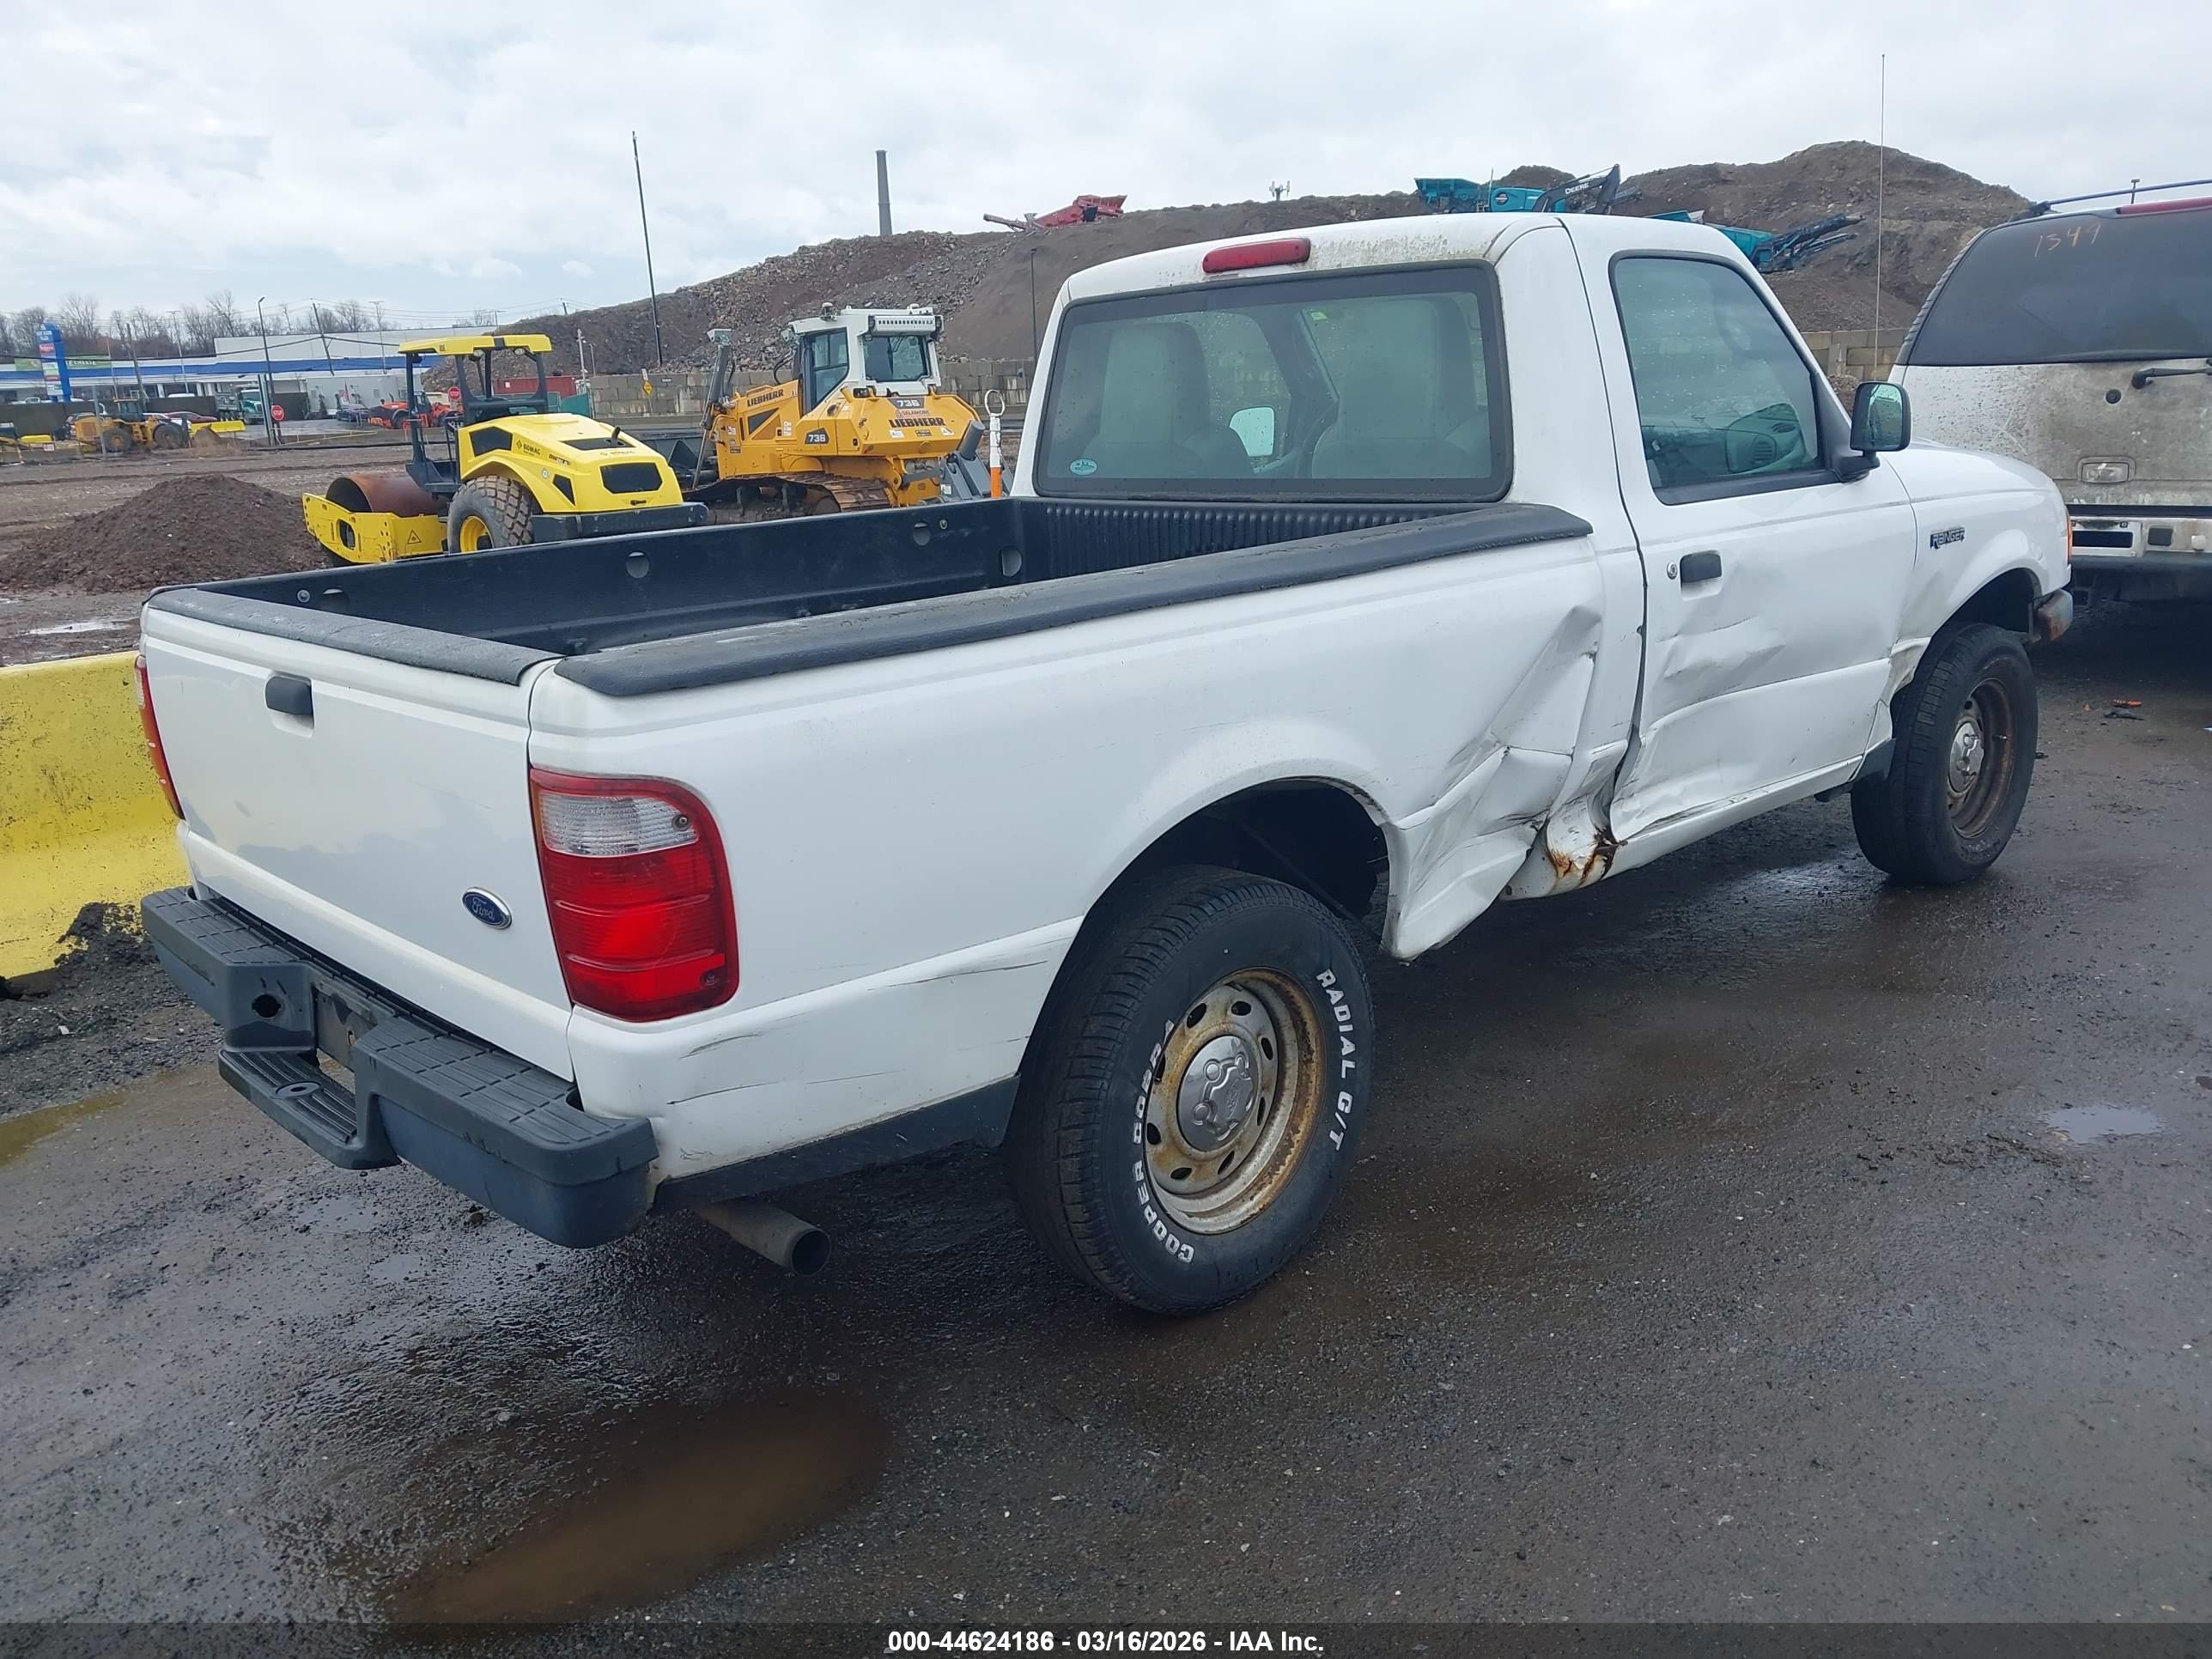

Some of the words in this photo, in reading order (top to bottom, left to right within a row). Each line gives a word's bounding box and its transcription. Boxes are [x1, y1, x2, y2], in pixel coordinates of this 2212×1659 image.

[1565, 182, 1589, 195] DEERE
[747, 389, 784, 407] LIEBHERR
[888, 417, 946, 428] LIEBHERR
[1316, 969, 1356, 1079] RADIAL
[1329, 1091, 1353, 1152] G/T
[1133, 1159, 1194, 1264] COOPER
